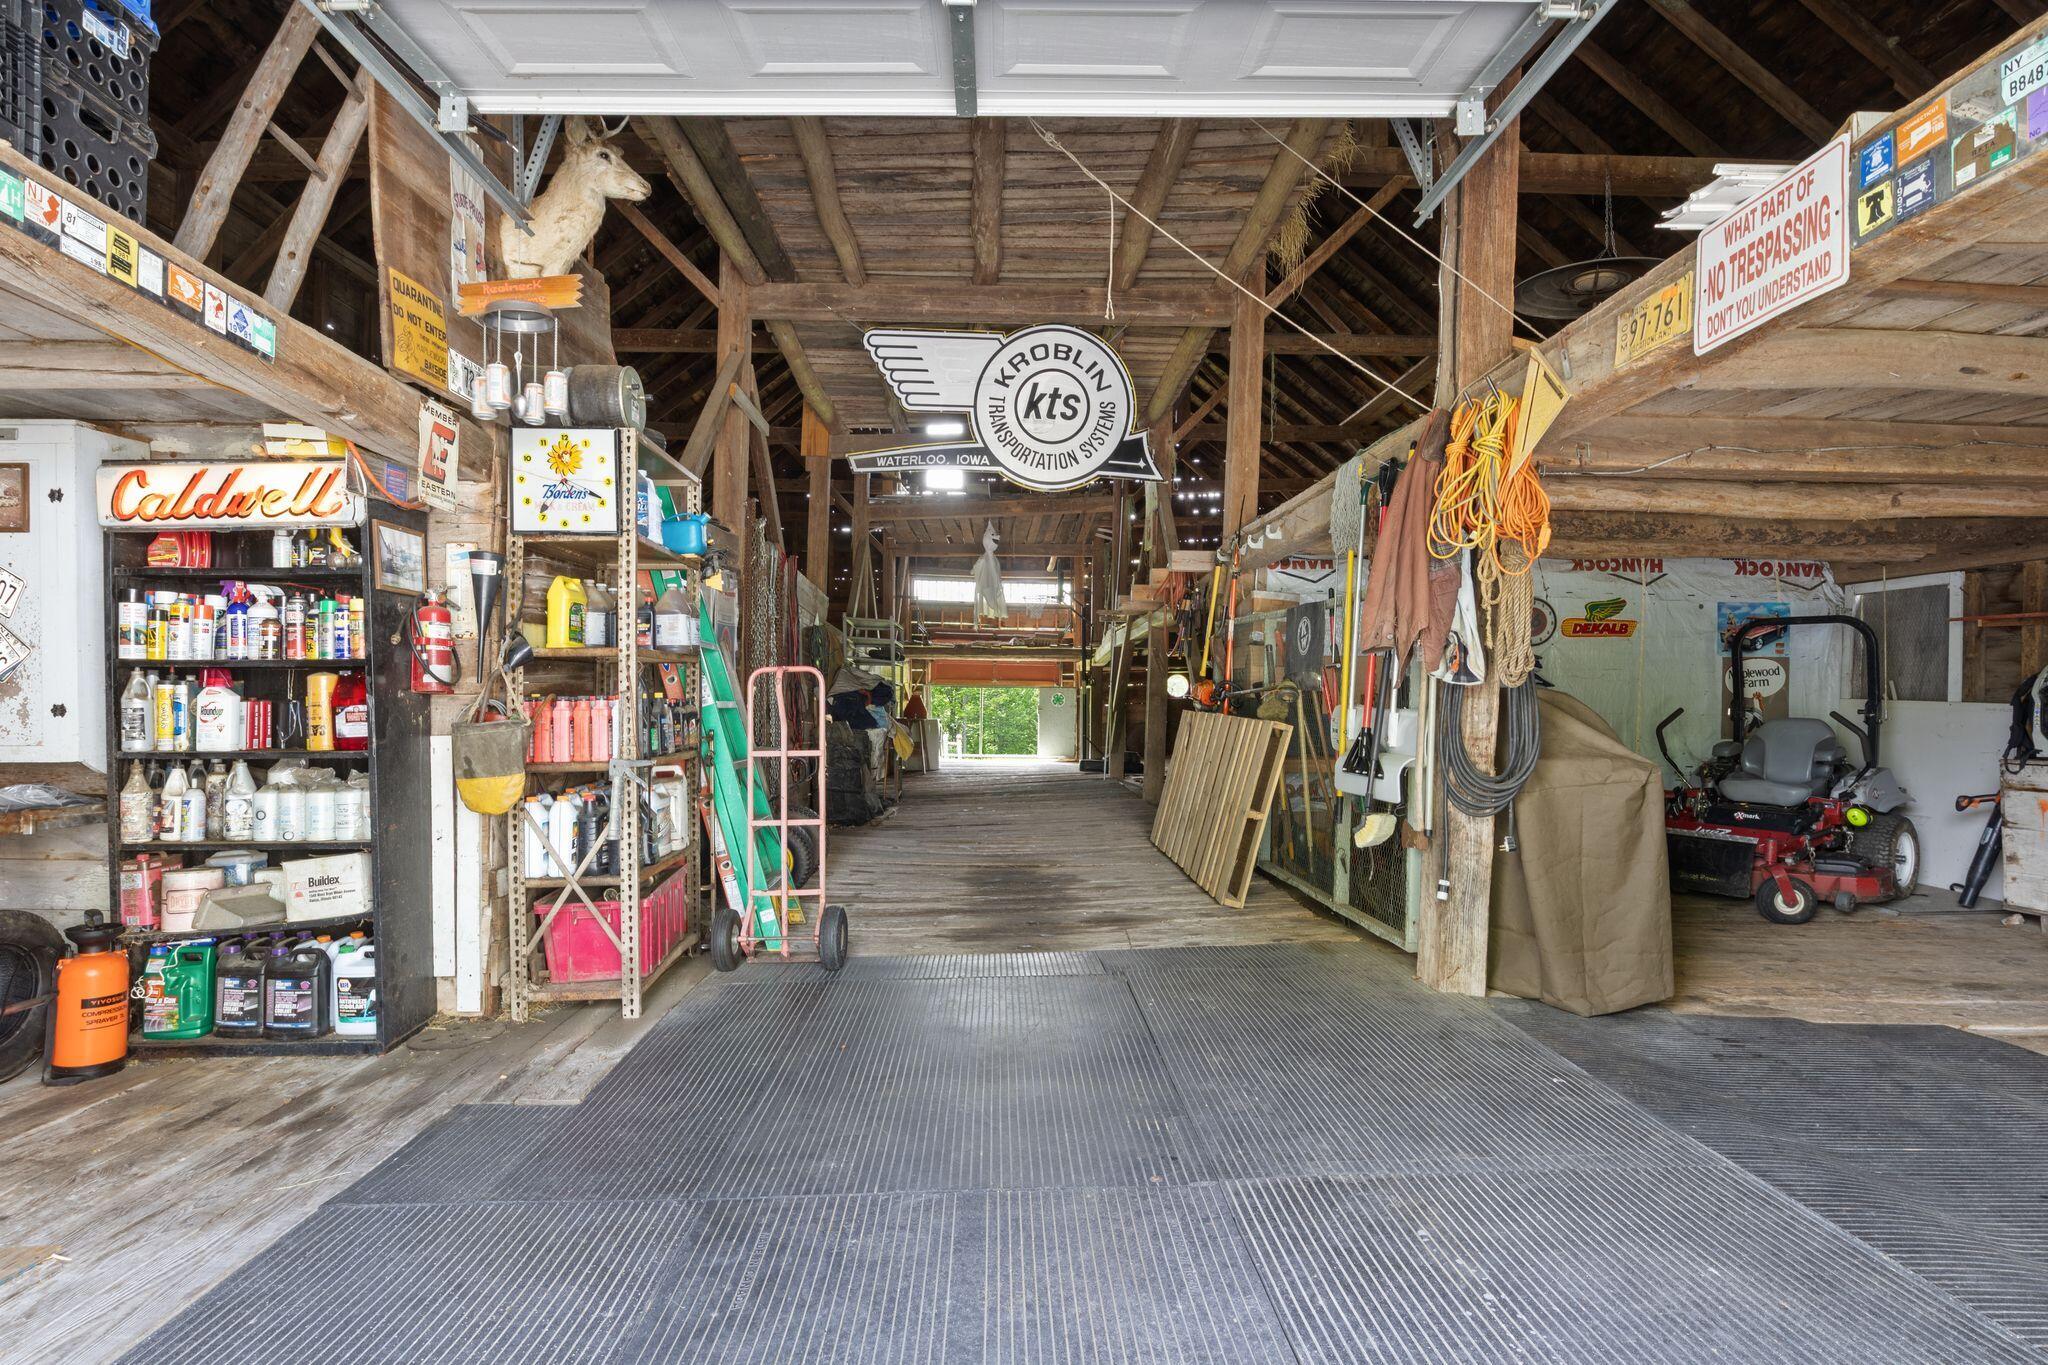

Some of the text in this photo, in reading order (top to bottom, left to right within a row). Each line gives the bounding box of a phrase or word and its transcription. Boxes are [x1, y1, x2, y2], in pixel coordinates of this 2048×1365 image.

[2003, 54, 2023, 76] NY
[27, 180, 43, 203] NJ
[66, 211, 77, 227] 81
[1724, 168, 1815, 249] WHAT PART OF
[1707, 194, 1831, 308] NO TRESPASSING
[393, 277, 443, 319] QUARANTINE
[1707, 250, 1832, 339] DON'T YOU UNDERSTAND
[393, 302, 404, 319] DO
[406, 310, 422, 328] NOT
[994, 342, 1113, 393] KROBLIN
[1023, 382, 1081, 421] kts
[423, 403, 458, 428] MEMBER
[988, 395, 1117, 471] TRANSPORTATION SYSTEMS
[956, 453, 991, 466] IOWA
[111, 466, 344, 521] Caldwell
[421, 479, 457, 500] EASTERN
[542, 483, 589, 500] Borden's
[1571, 621, 1630, 635] DEKALB
[1728, 666, 1780, 679] Mplewood
[200, 705, 224, 717] Roundup
[308, 874, 340, 888] Buildex
[86, 1014, 118, 1026] SPRAYER
